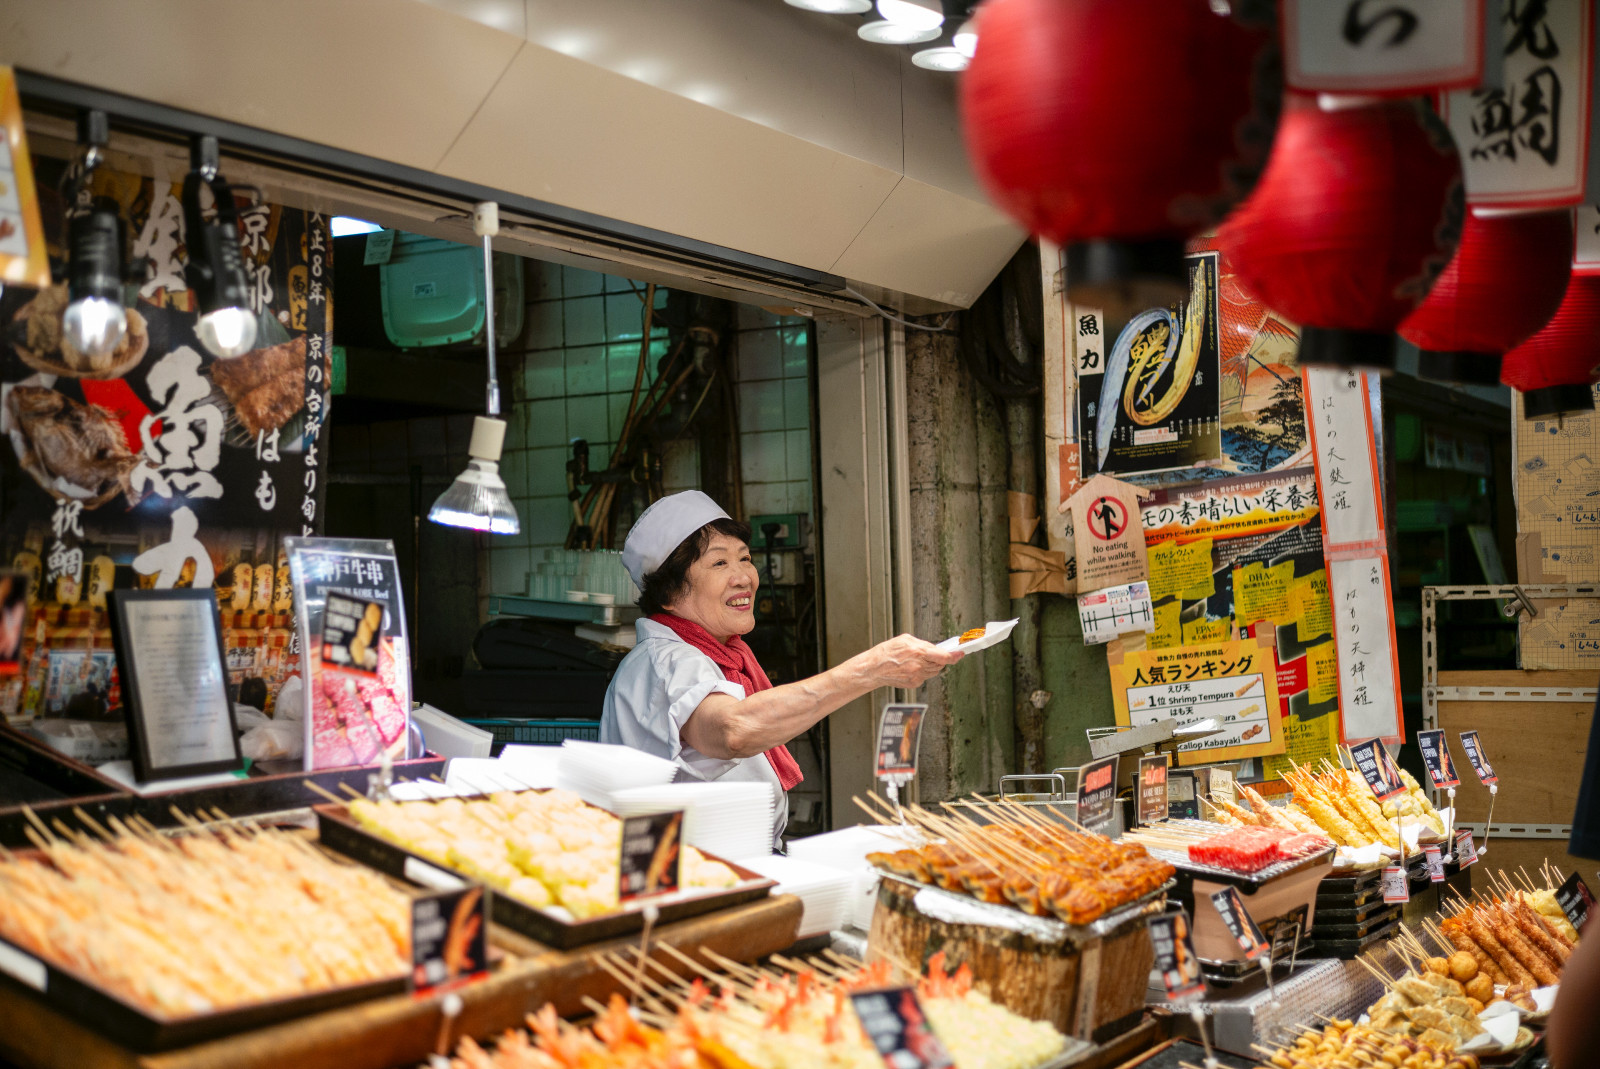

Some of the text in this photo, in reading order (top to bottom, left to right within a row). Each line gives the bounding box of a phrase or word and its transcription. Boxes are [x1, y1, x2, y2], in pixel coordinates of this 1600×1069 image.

[1079, 313, 1100, 370] 魚力
[255, 428, 281, 511] はも
[1092, 541, 1129, 554] No eating
[1086, 550, 1137, 566] while walking
[1132, 654, 1253, 686] 人気ランキング
[1168, 683, 1191, 694] えび天
[1168, 694, 1197, 705] Shrimp
[1199, 691, 1234, 702] Tempura
[1170, 706, 1194, 716] はも天
[1204, 736, 1241, 748] Kabayaki
